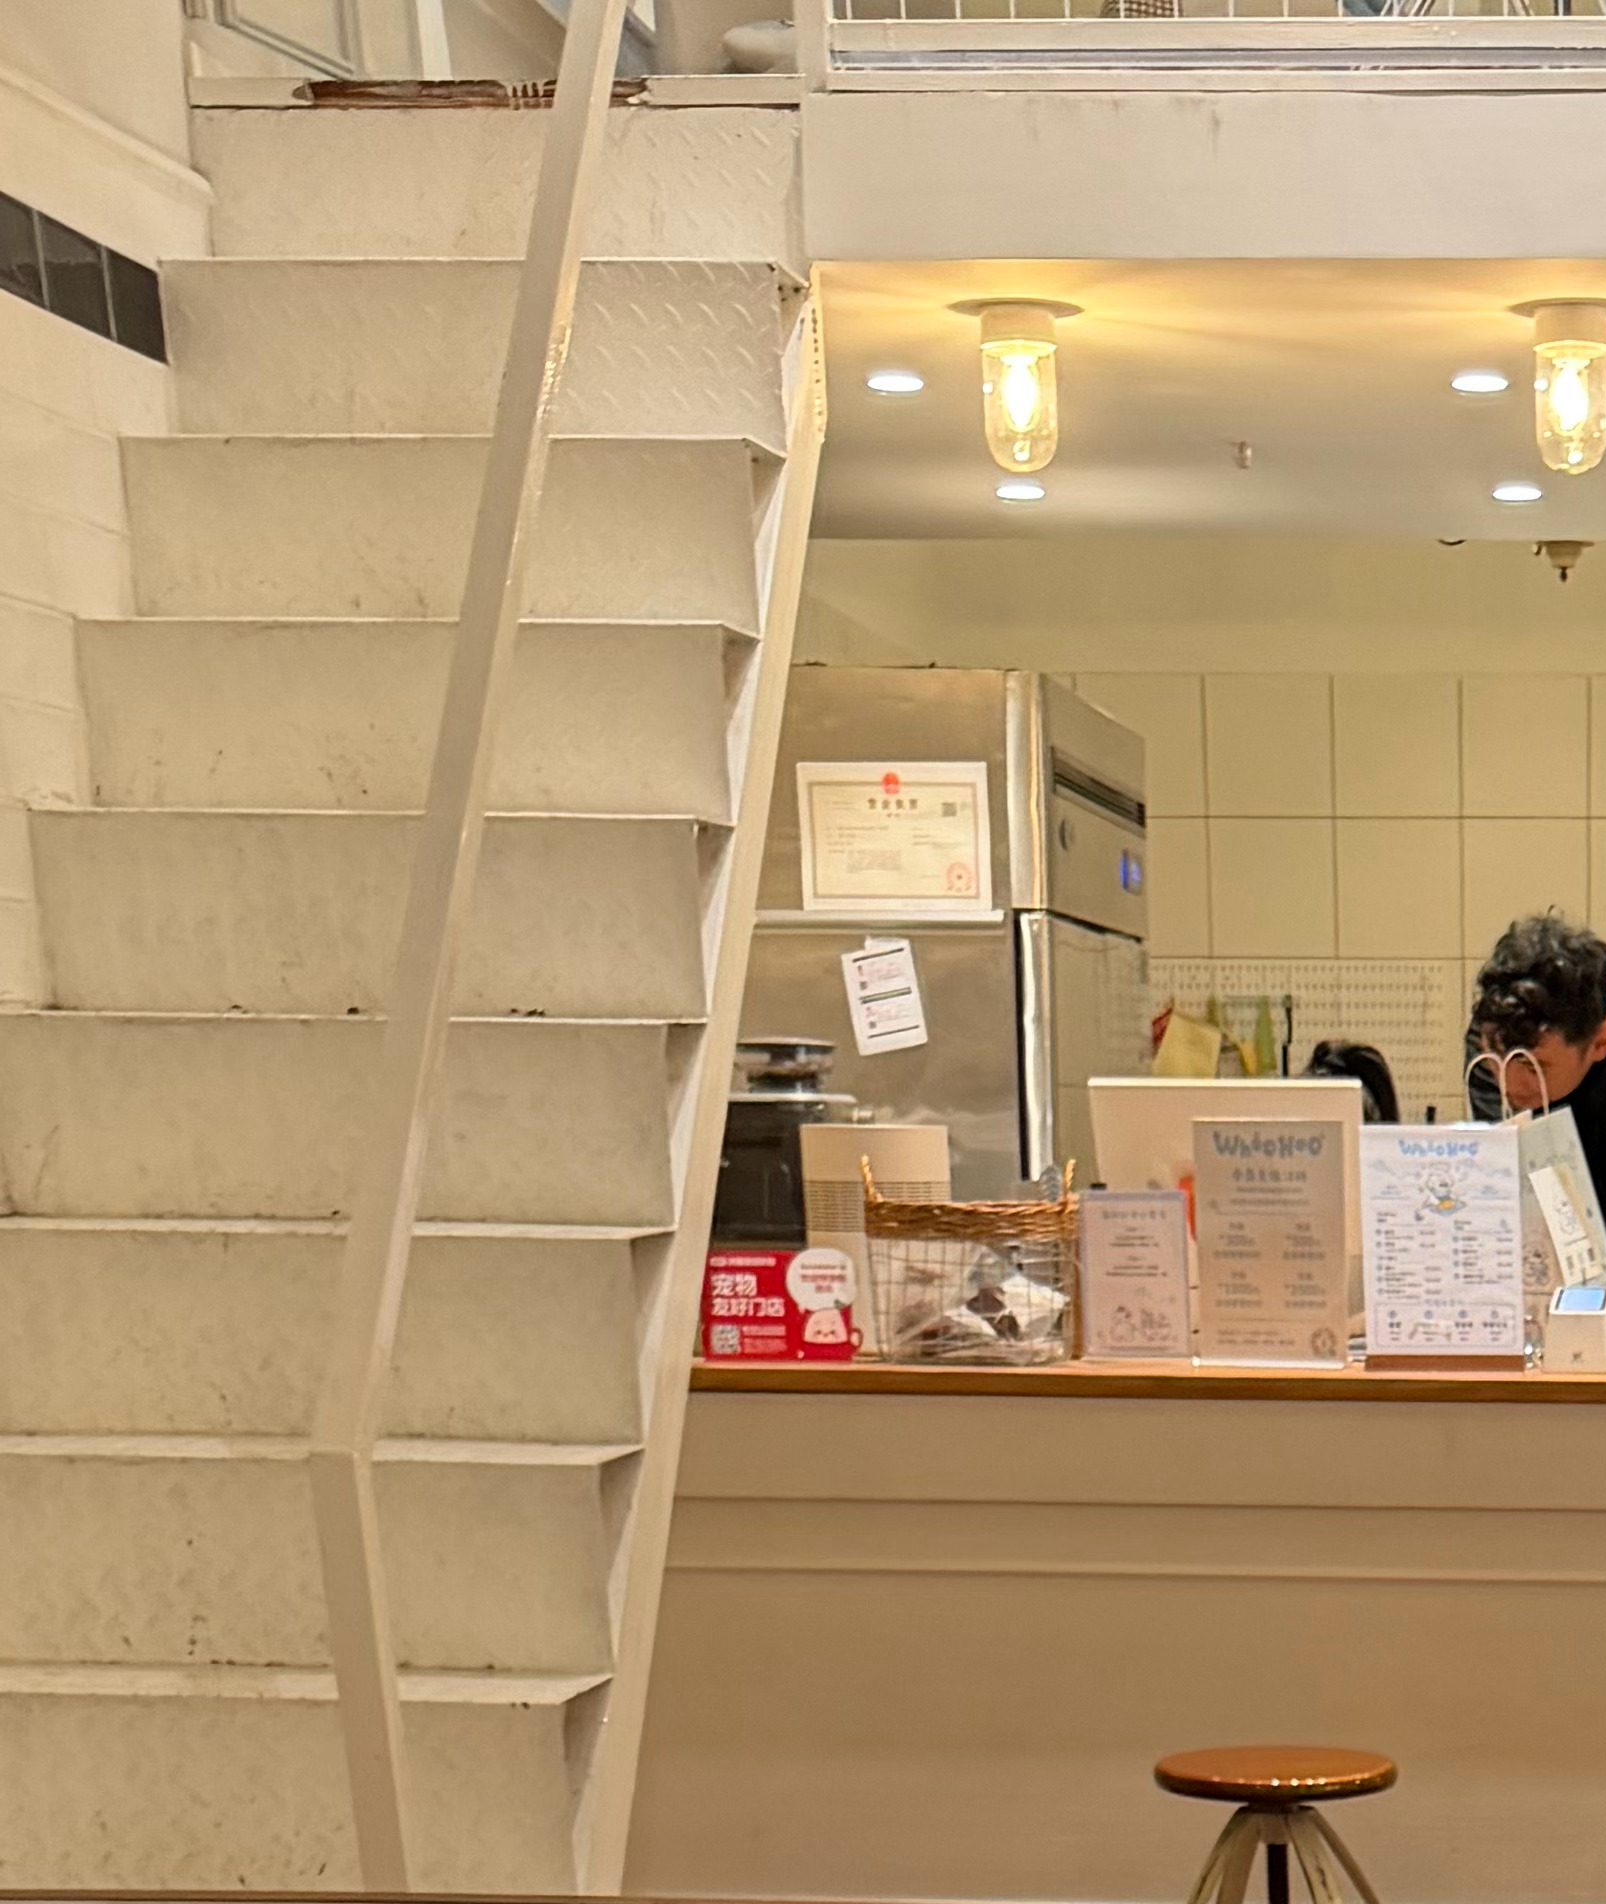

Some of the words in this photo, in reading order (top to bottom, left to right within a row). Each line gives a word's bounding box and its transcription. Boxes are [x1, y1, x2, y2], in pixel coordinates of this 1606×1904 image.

[711, 1274, 757, 1296] 宠物
[711, 1297, 785, 1317] 友好门店
